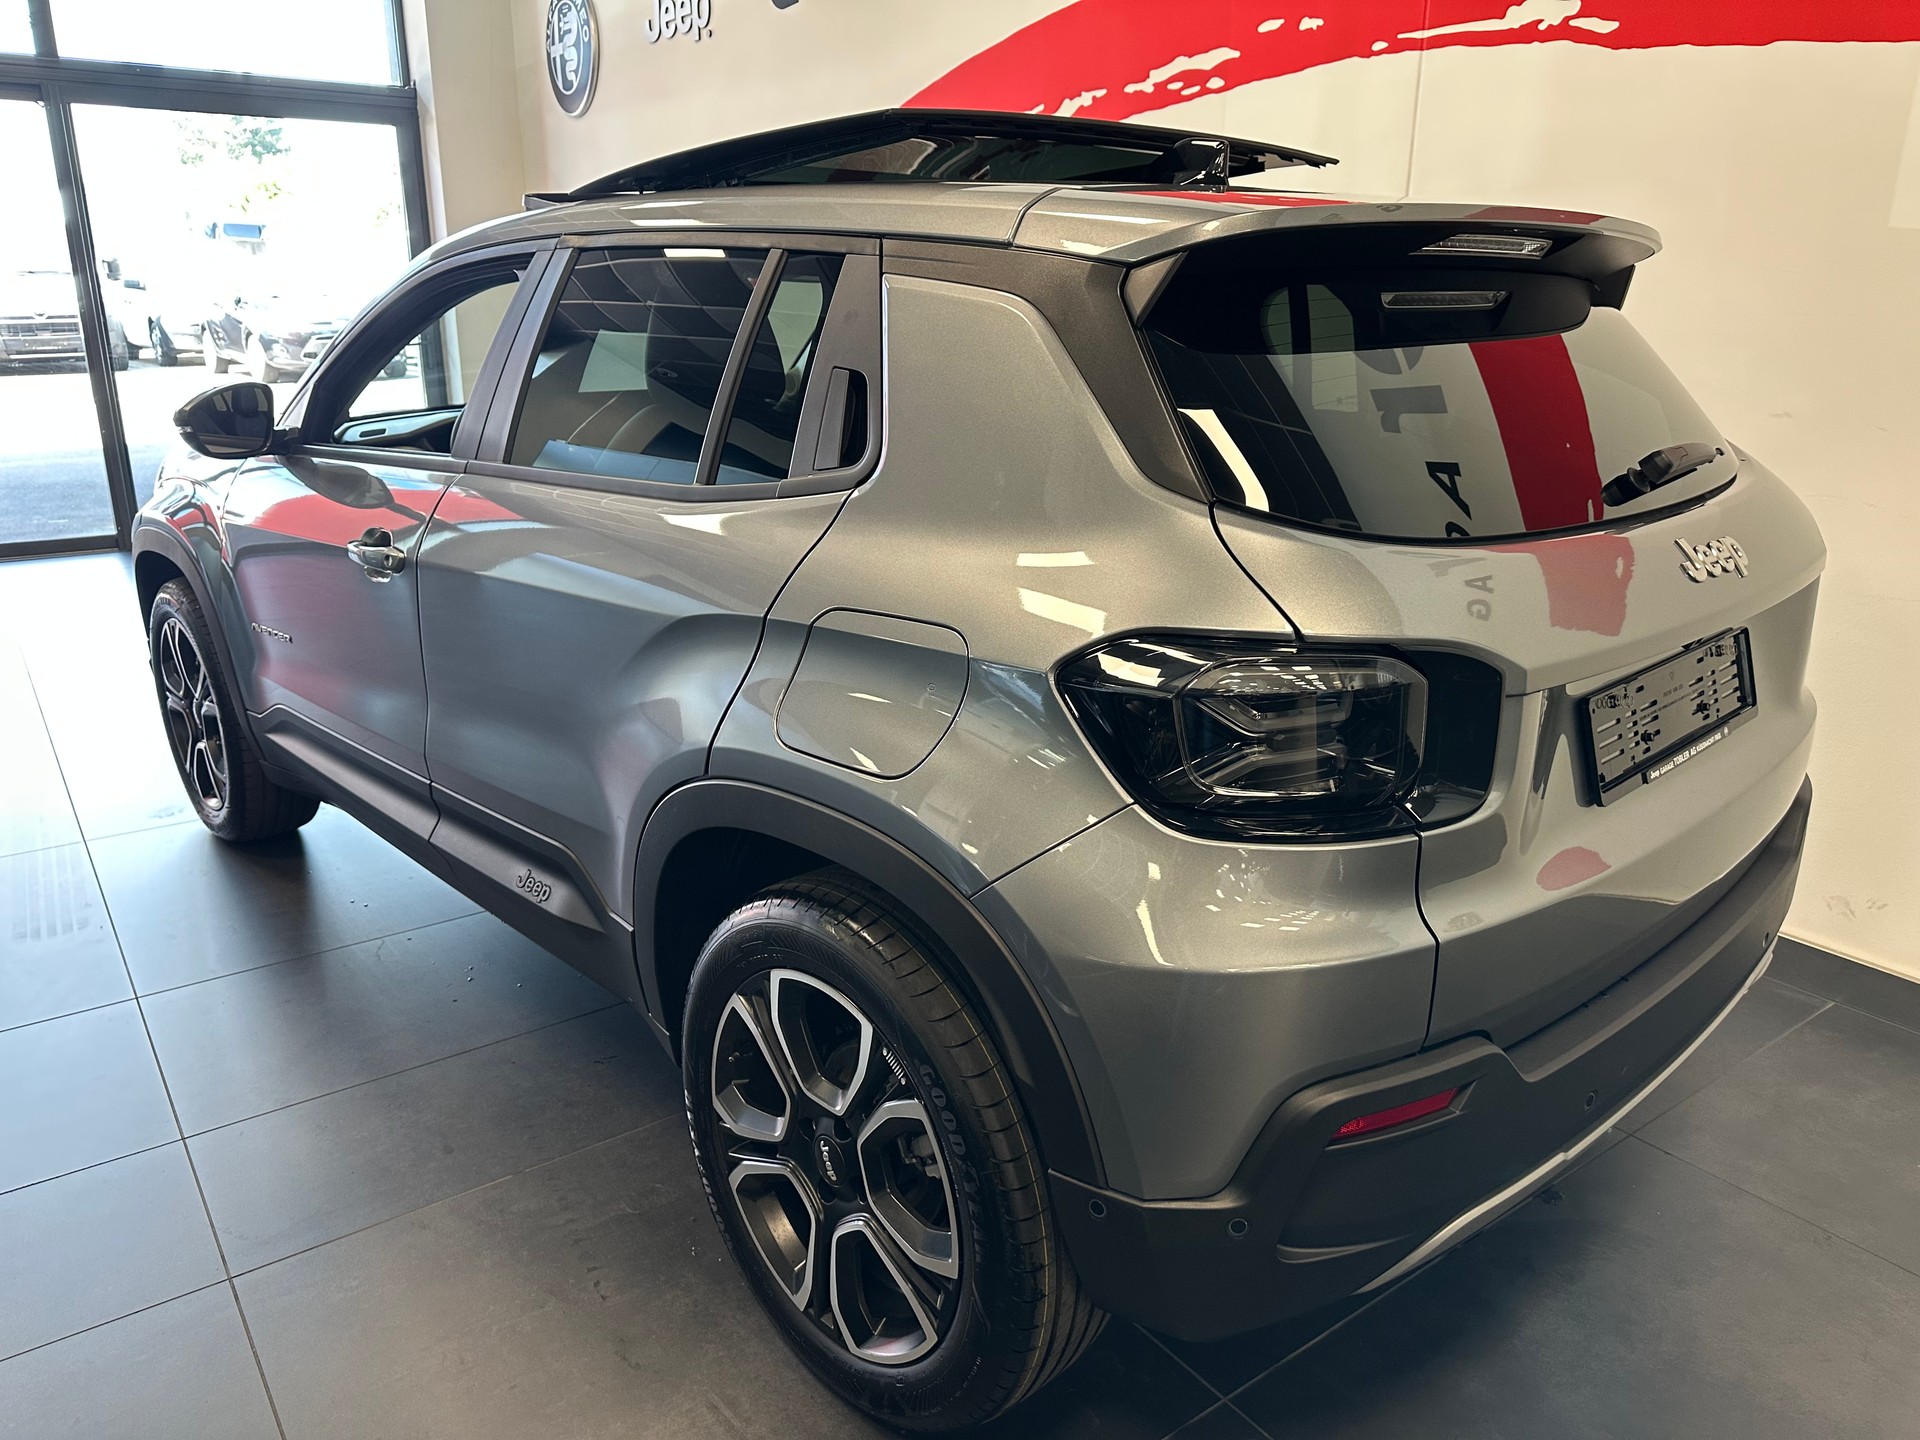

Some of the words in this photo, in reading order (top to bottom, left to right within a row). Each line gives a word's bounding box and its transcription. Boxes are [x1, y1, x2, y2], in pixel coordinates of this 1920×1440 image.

[1673, 535, 1749, 583] Jeep
[1650, 770, 1659, 779] Jeep
[1660, 762, 1674, 774] GARAGE
[1673, 751, 1689, 765] TOBLER
[1690, 747, 1697, 756] AG
[516, 868, 552, 904] Jeep
[820, 1140, 837, 1181] Jeep
